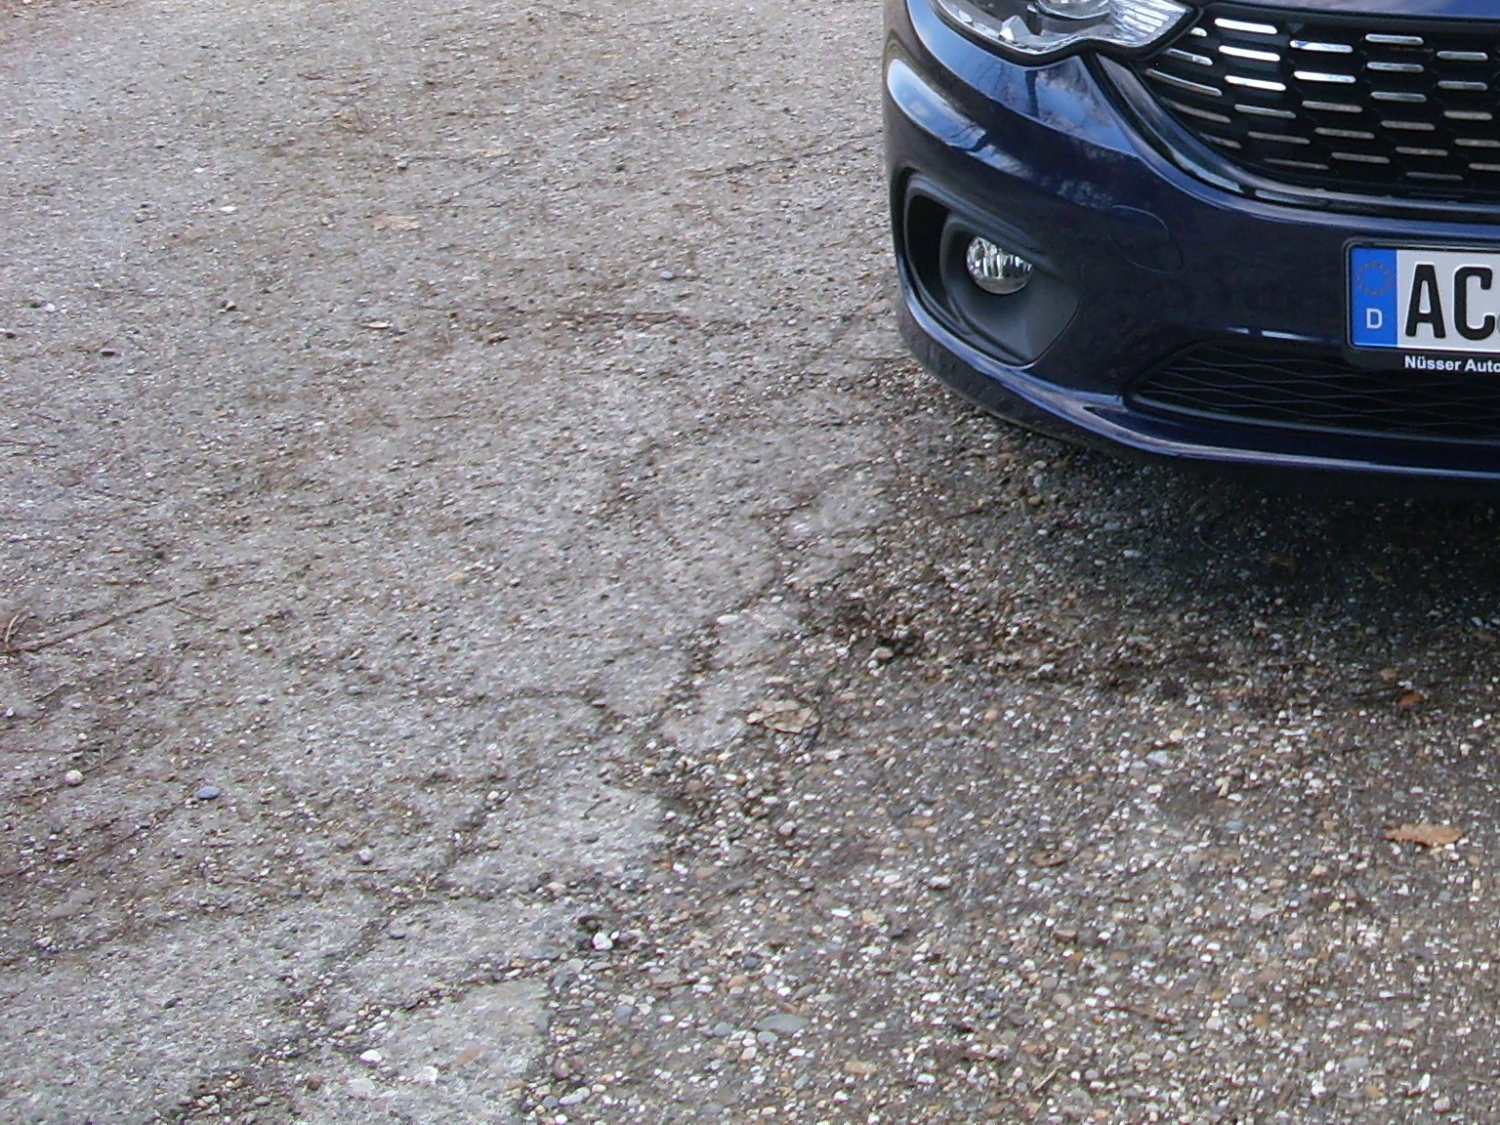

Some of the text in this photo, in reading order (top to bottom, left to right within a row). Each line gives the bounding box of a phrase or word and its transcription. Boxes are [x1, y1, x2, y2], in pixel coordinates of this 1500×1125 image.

[1405, 263, 1496, 341] AC
[1366, 308, 1383, 329] D
[1404, 355, 1461, 371] Nüsser
